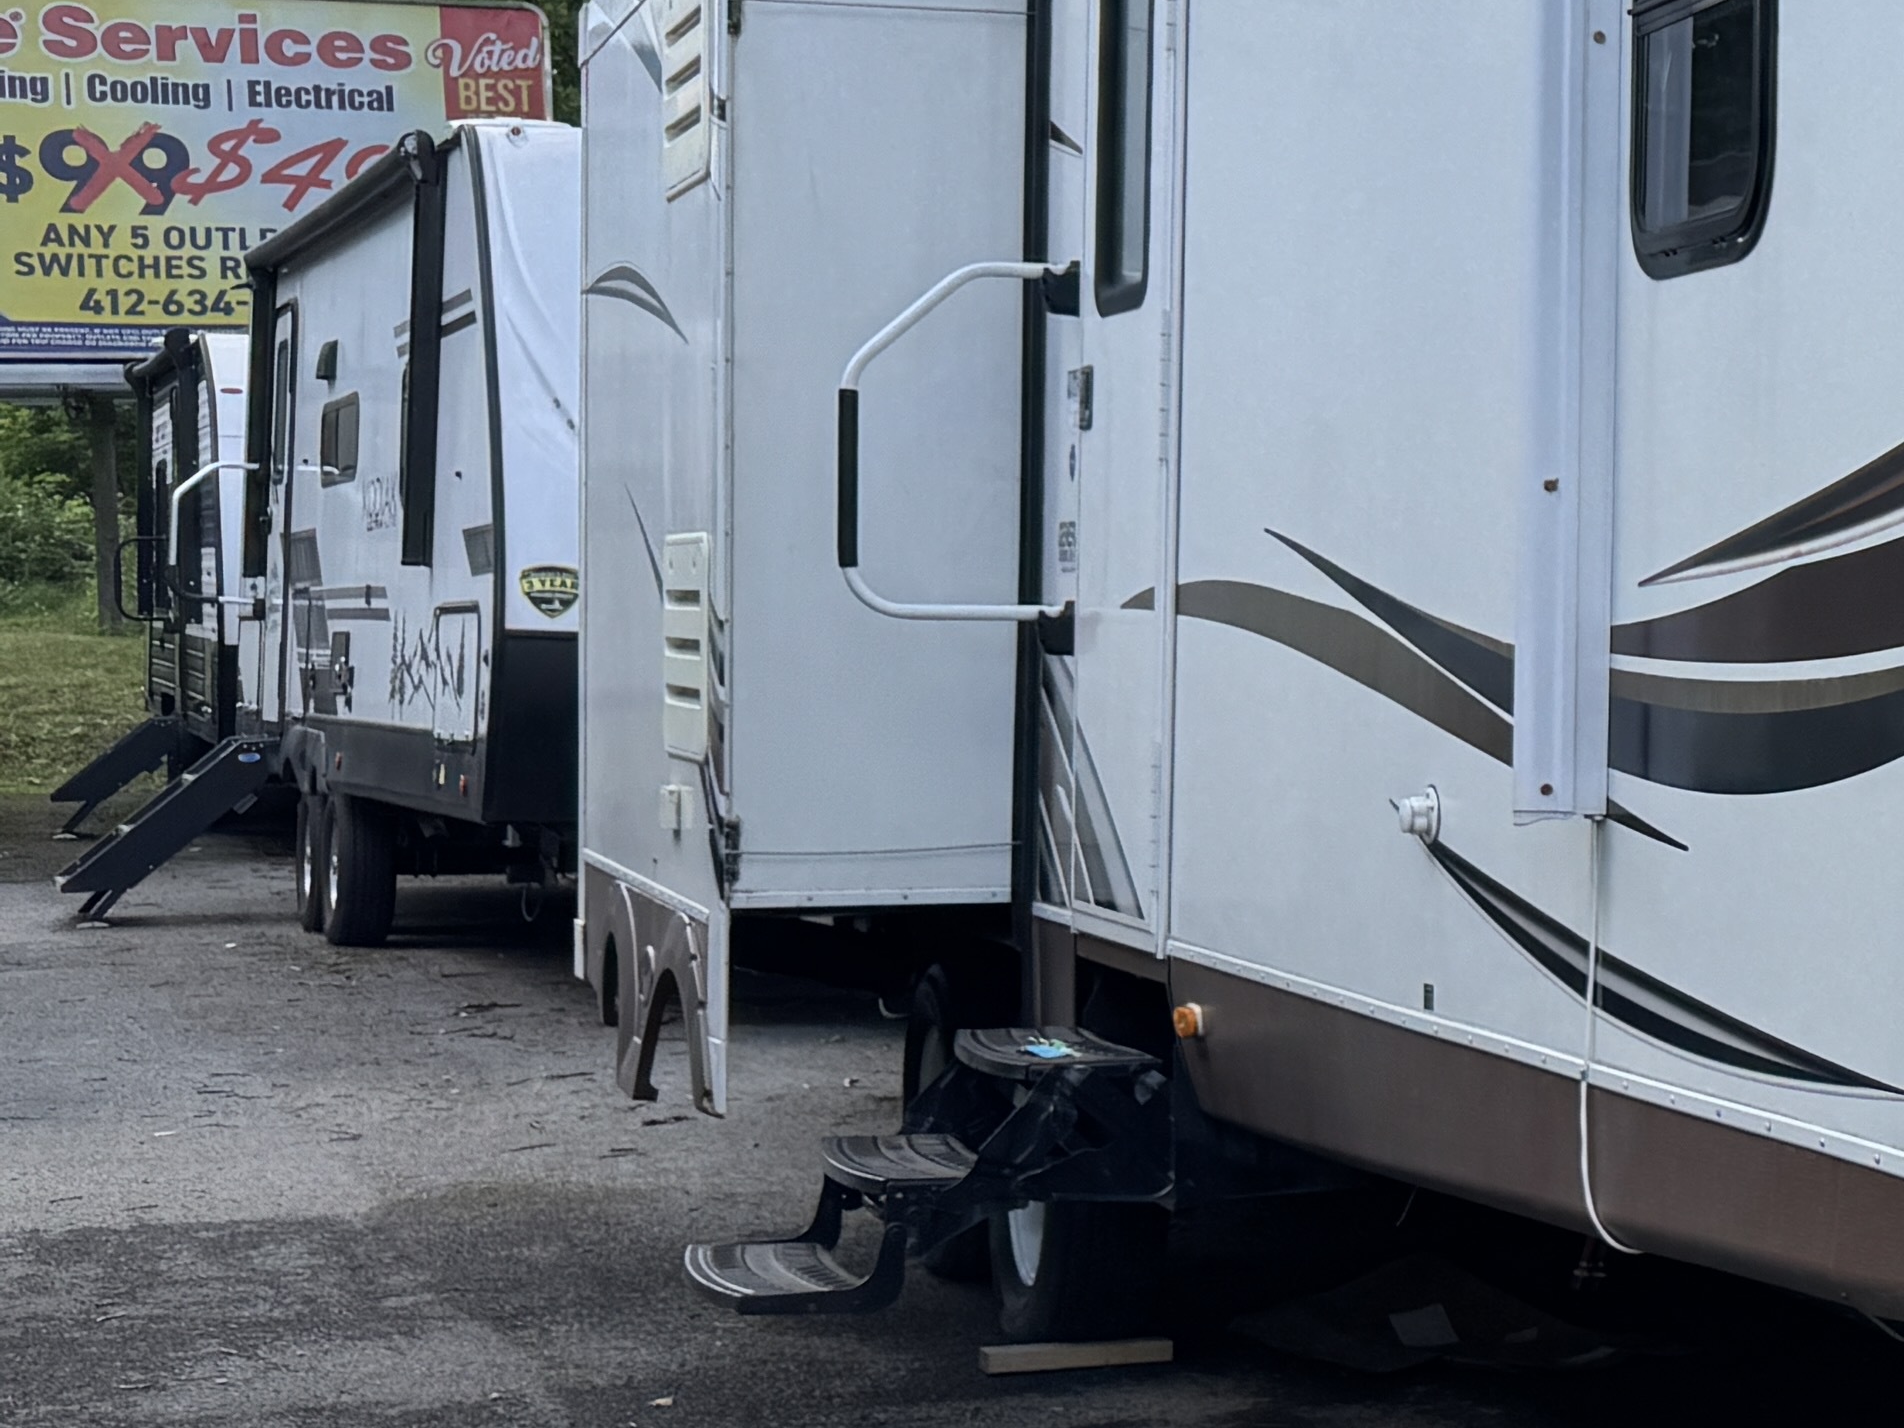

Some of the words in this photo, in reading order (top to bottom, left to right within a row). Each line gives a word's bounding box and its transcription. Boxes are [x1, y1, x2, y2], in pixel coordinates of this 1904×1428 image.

[41, 4, 413, 71] Services
[425, 32, 540, 77] Voted
[86, 73, 211, 109] Cooling
[247, 80, 395, 112] Electrical
[458, 77, 534, 113] BEST
[40, 223, 117, 249] ANY
[130, 225, 150, 250] 5
[14, 252, 207, 280] SWITCHES
[79, 287, 249, 317] 412-634-
